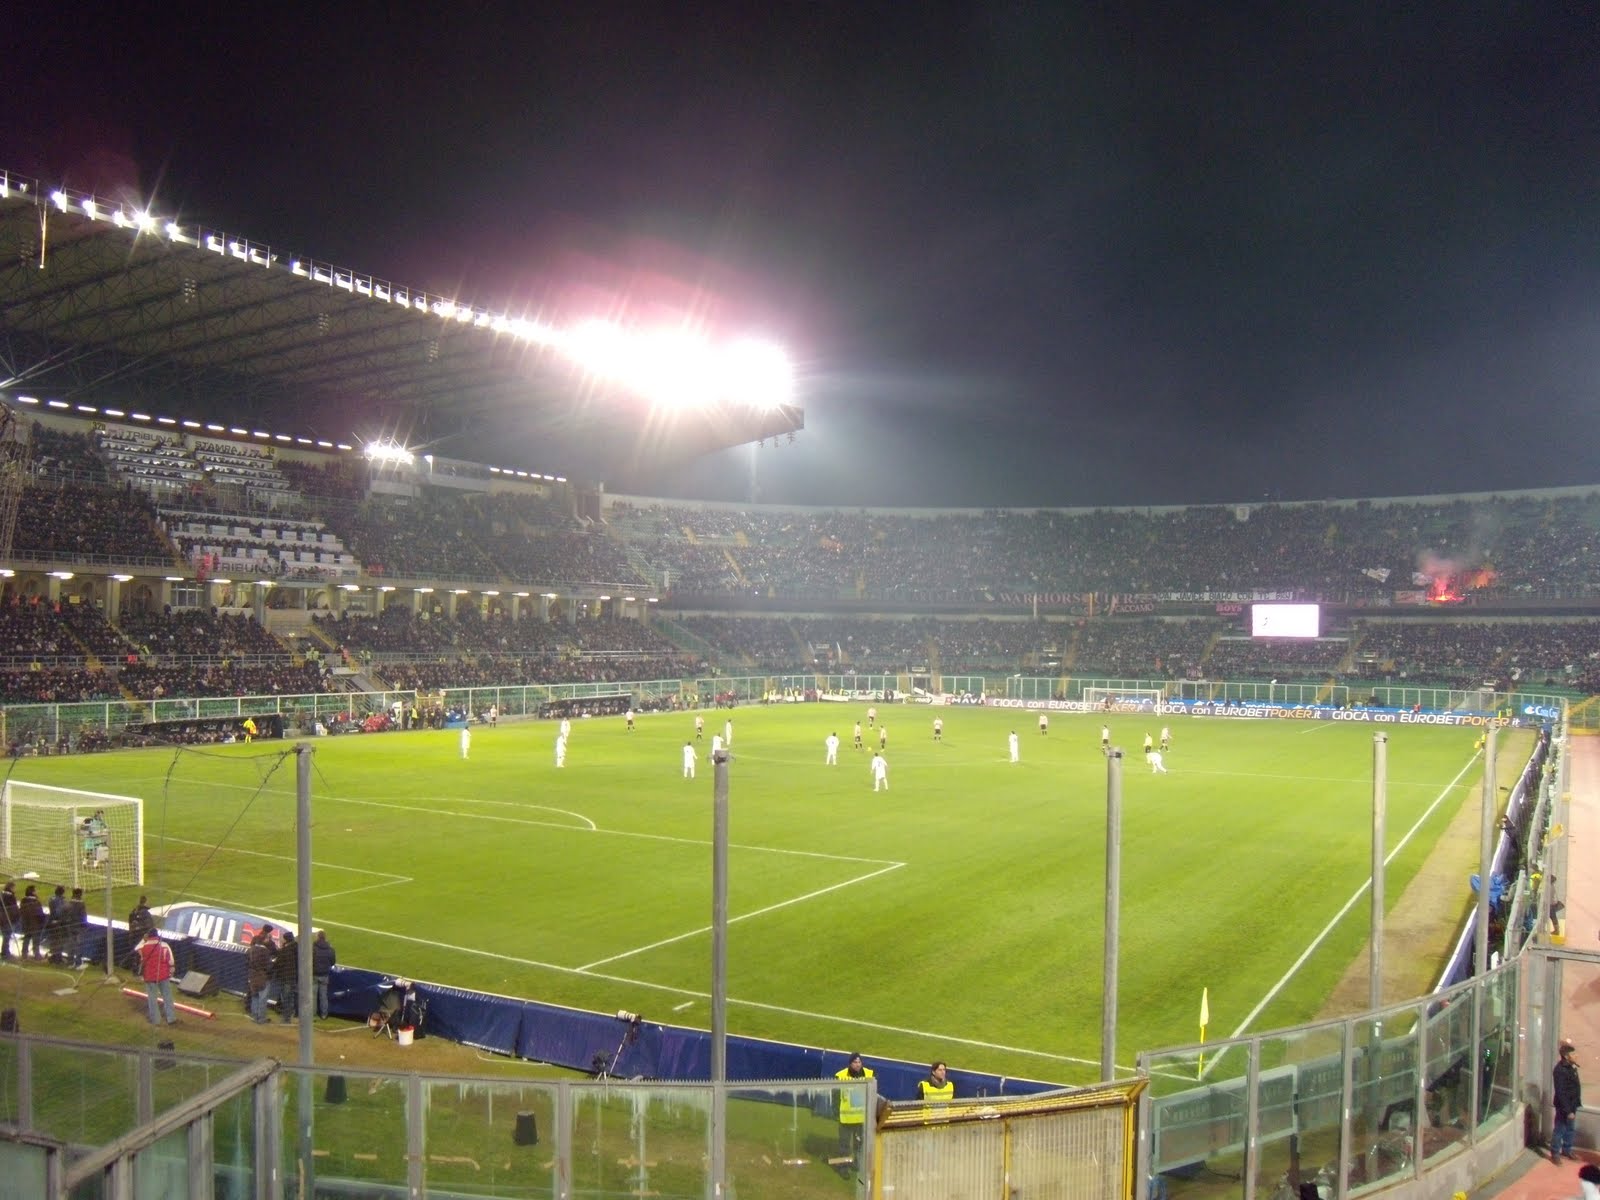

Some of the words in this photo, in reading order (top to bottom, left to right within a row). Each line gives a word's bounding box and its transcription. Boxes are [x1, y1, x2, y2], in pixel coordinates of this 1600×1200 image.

[993, 698, 1023, 708] GIOCA
[1027, 701, 1044, 709] con
[1153, 704, 1187, 715] GIOCA
[1191, 707, 1211, 716] con
[1214, 706, 1321, 719] EUROBETPOKER.it
[1332, 709, 1370, 722] GIOCA
[1374, 713, 1396, 723] con
